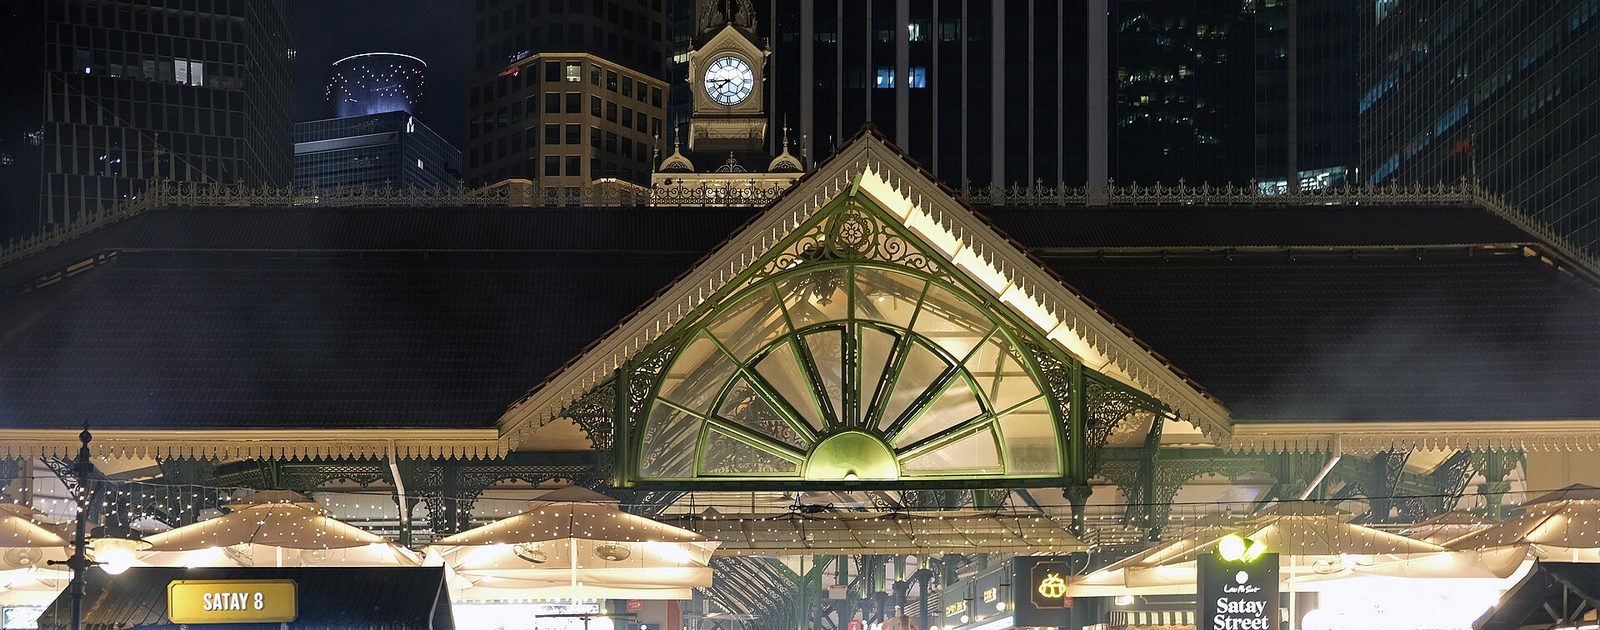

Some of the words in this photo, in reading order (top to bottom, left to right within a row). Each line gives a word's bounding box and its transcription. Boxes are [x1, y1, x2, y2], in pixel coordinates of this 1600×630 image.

[203, 592, 249, 611] SATAY
[254, 592, 264, 611] 8
[1216, 597, 1267, 617] Satay
[1213, 614, 1270, 630] Street
